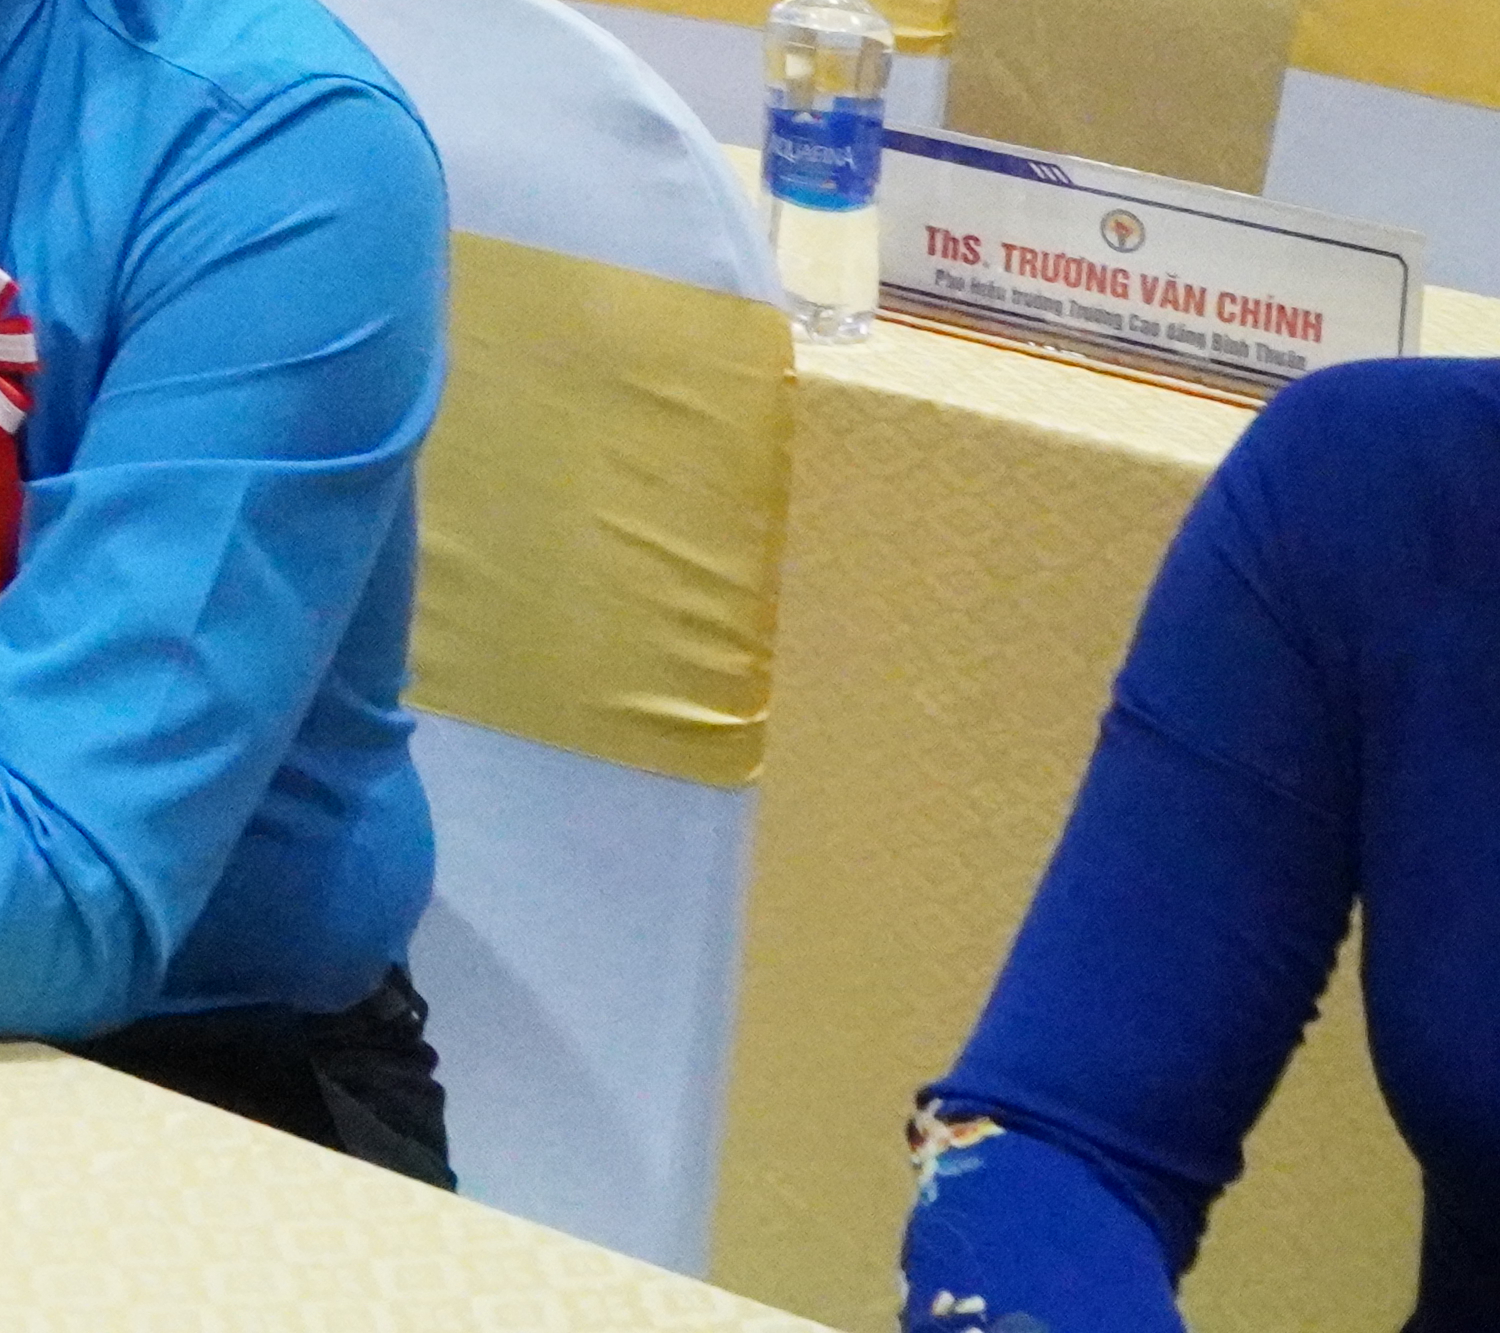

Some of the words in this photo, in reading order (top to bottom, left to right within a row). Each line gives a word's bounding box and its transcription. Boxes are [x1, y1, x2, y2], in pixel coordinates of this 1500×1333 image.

[924, 224, 990, 268] ThS.
[1139, 270, 1208, 318] VĂN
[1215, 291, 1323, 344] CHÍNH
